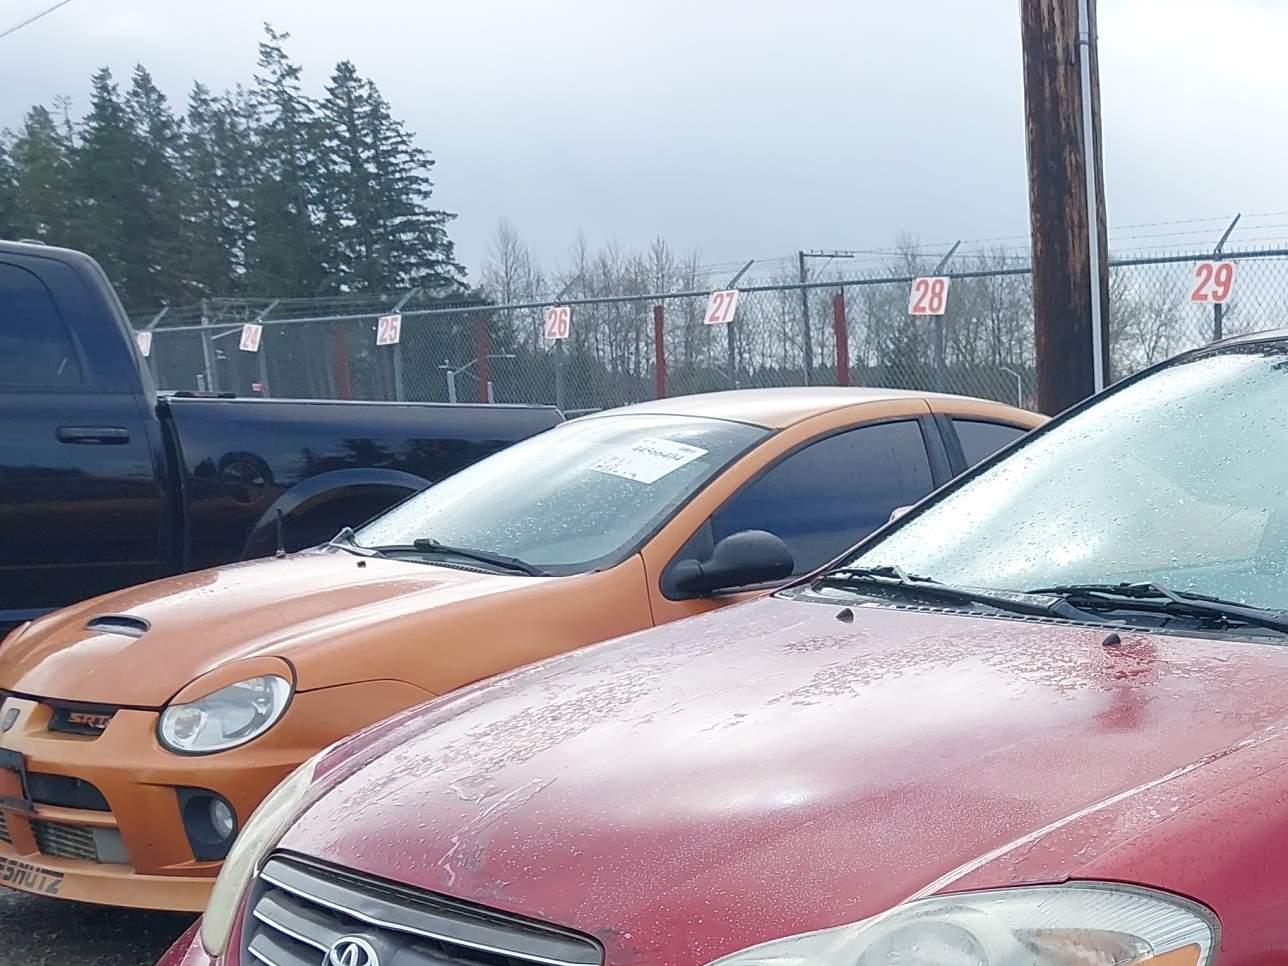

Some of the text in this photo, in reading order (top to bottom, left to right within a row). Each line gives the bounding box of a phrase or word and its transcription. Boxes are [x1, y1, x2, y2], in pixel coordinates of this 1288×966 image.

[912, 278, 945, 314] 28
[1191, 263, 1233, 302] 29
[708, 291, 736, 322] 27
[243, 325, 260, 349] 24
[379, 316, 400, 343] 25
[547, 308, 568, 337] 26
